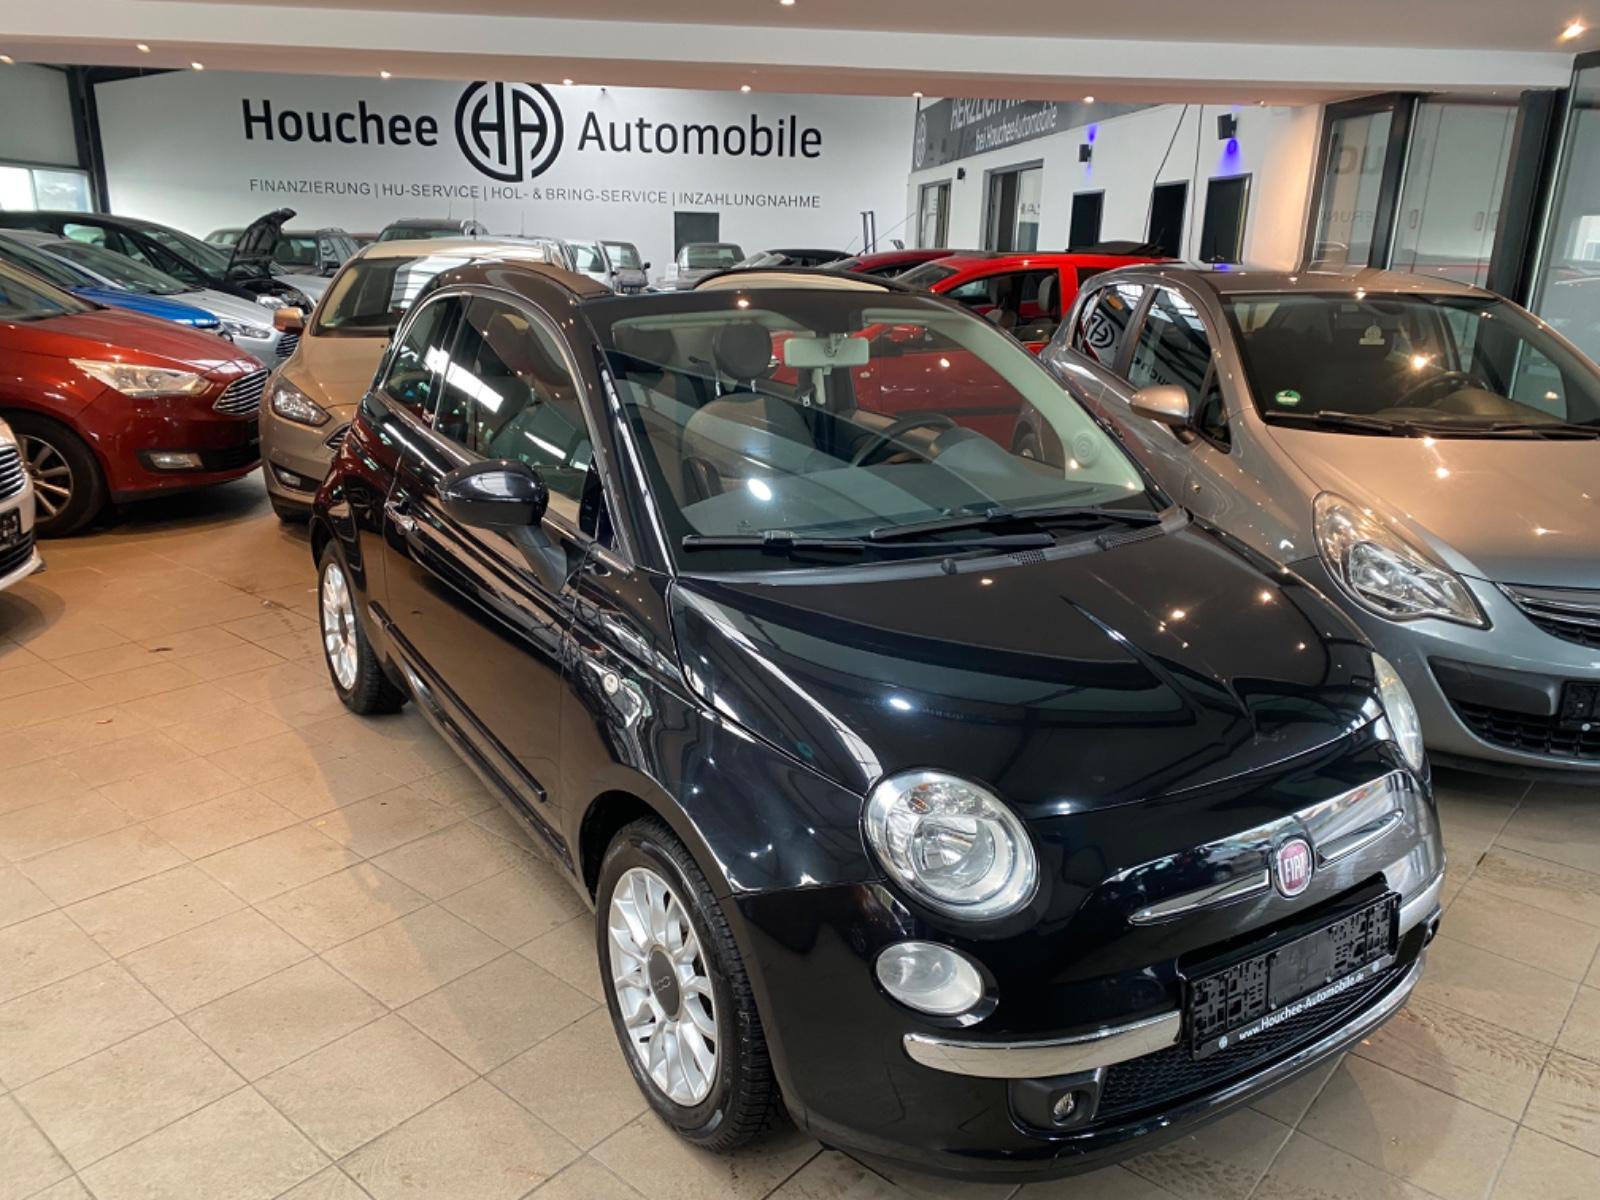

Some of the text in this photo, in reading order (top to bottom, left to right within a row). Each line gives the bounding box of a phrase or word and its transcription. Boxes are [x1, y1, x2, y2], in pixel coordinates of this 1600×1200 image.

[242, 98, 439, 147] Houchee
[577, 111, 822, 159] Automobile
[249, 178, 821, 209] FINANZIERUNG HU-SERVICE HOL- & BRING-SERVICE INZAHLUNGNAHME
